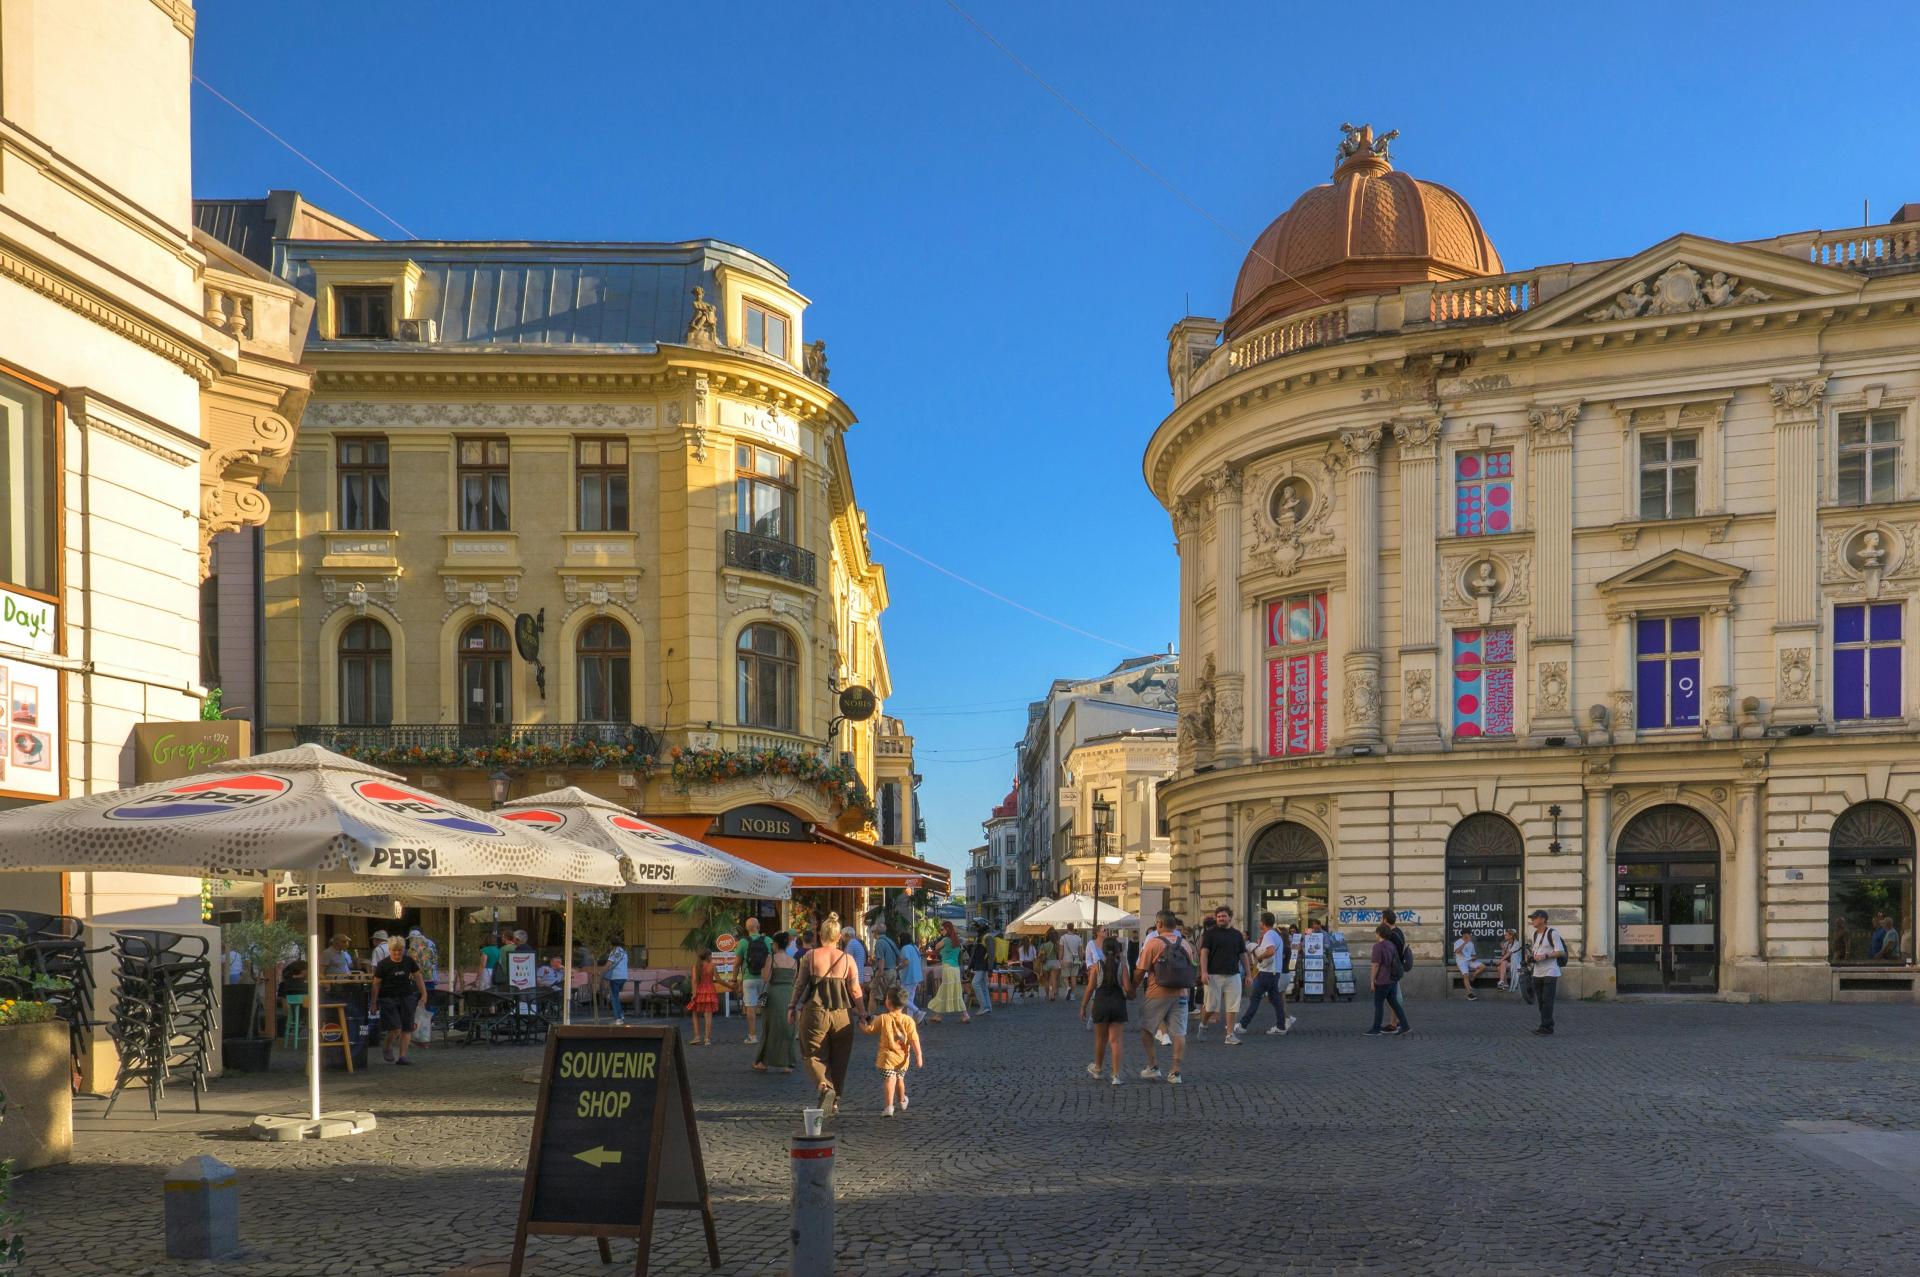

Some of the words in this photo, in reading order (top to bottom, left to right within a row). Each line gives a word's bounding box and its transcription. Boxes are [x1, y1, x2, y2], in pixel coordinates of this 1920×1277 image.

[4, 595, 46, 638] Day!
[1274, 661, 1283, 683] visit
[1290, 659, 1308, 715] Safari
[1290, 717, 1308, 749] Art
[740, 817, 790, 834] NOBIS
[370, 846, 438, 870] PEPSI
[639, 863, 675, 881] PEPSI
[1452, 904, 1480, 912] FROM
[1482, 903, 1503, 912] OUR
[1452, 912, 1488, 920] WORLD
[1452, 920, 1504, 928] CHAMPION
[559, 1051, 656, 1079] SOUVENIR
[576, 1090, 631, 1118] SHOP
